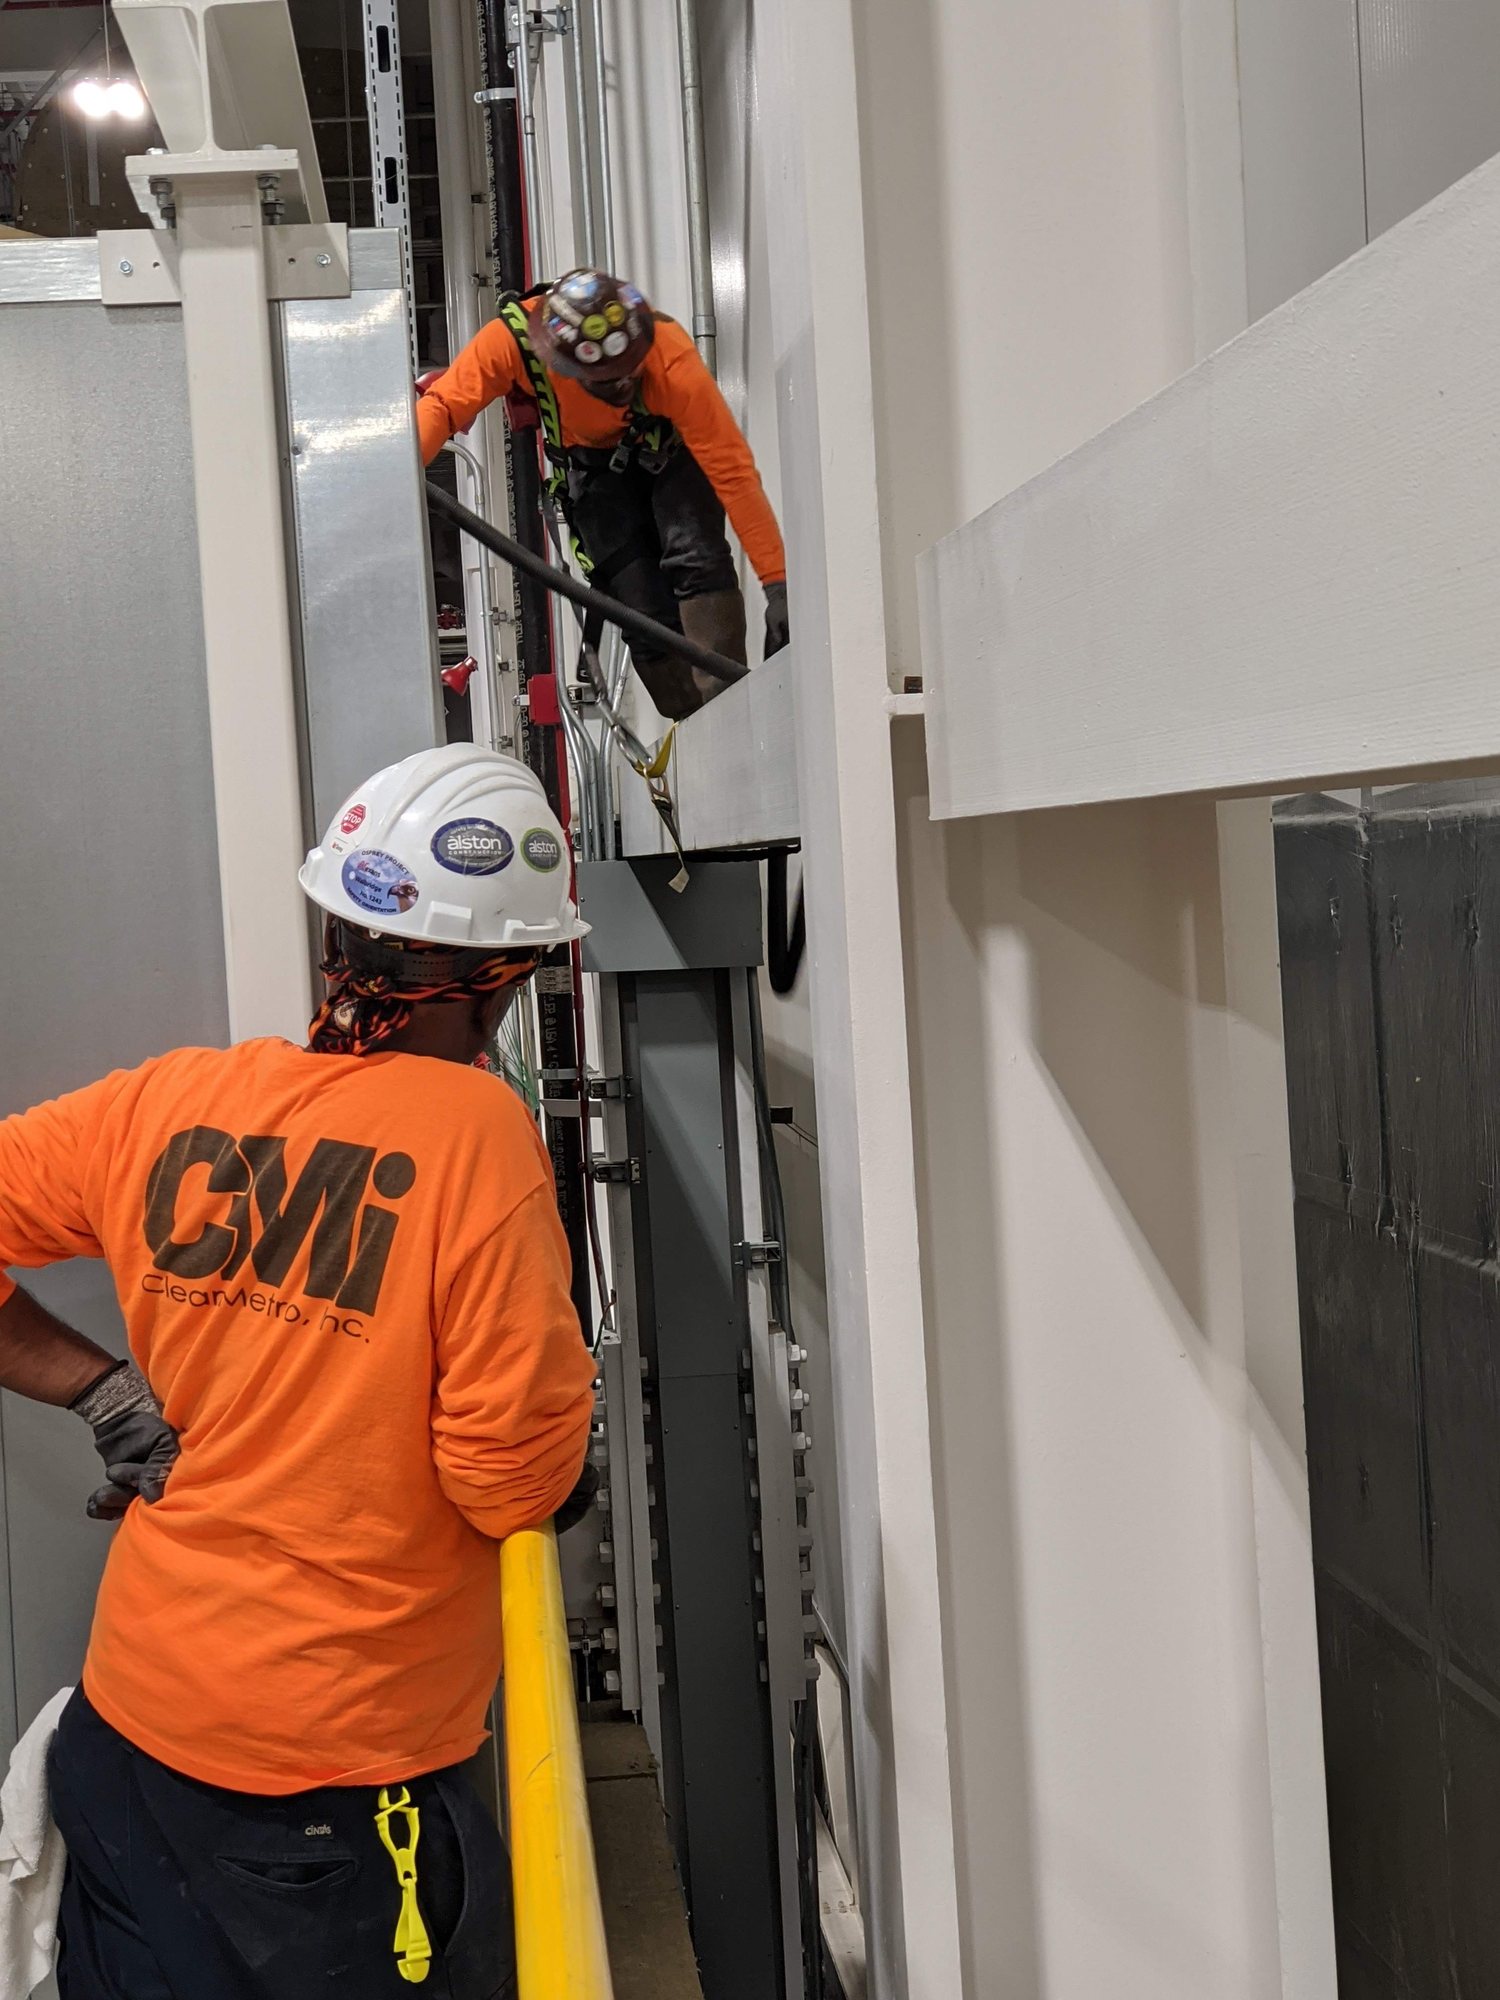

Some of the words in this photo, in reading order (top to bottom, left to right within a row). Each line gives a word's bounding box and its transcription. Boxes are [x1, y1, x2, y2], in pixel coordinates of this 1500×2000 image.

[504, 454, 513, 477] CODE
[515, 620, 524, 645] TYLER
[343, 812, 363, 825] STOP
[447, 835, 502, 850] alston
[529, 840, 558, 854] alston
[361, 850, 385, 858] OSPREY
[385, 855, 410, 876] PROJECT
[355, 876, 383, 893] Walbridge
[369, 894, 383, 905] 1243
[361, 902, 397, 913] ORIENTATION
